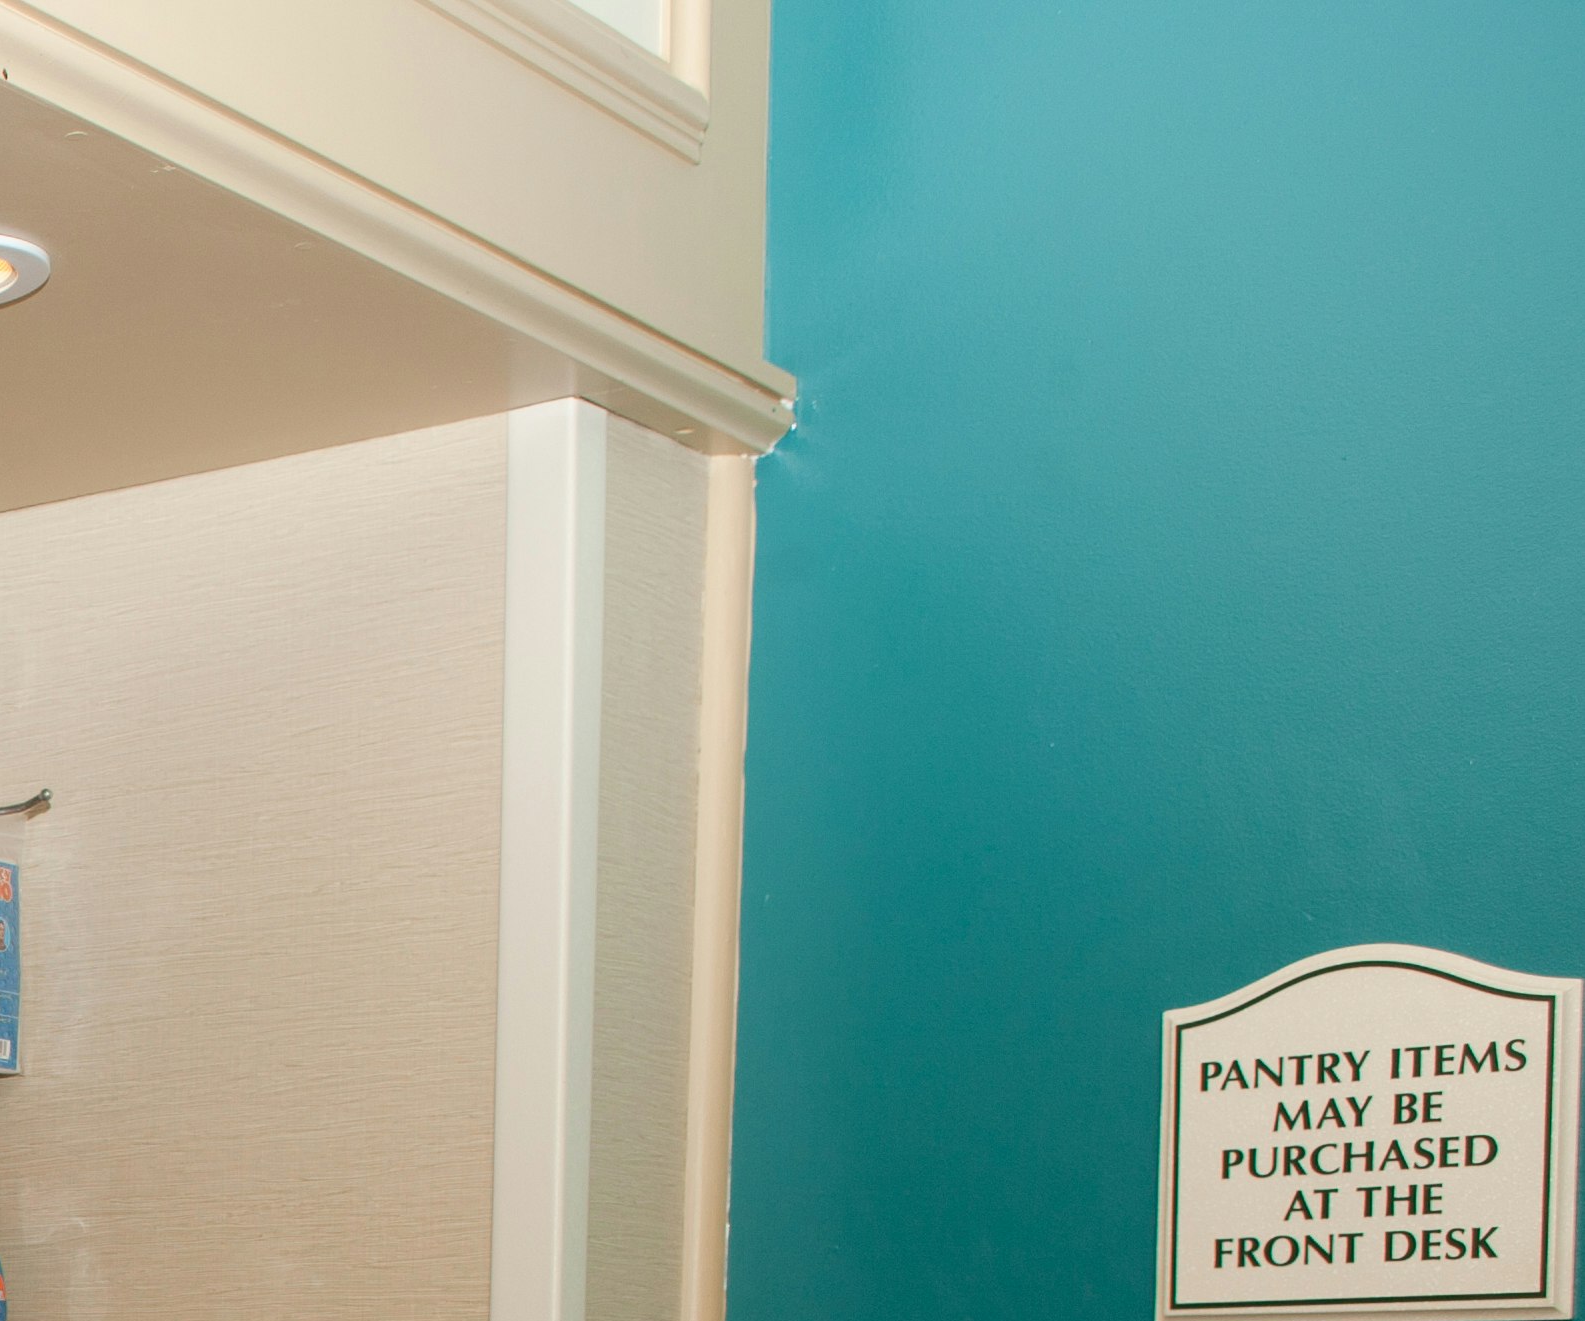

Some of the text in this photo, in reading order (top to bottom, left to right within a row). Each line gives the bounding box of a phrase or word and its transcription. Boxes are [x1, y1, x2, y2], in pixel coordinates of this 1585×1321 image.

[1199, 1038, 1528, 1093] PANTRY ITEMS
[1272, 1090, 1444, 1133] MAY BE
[1220, 1133, 1500, 1181] PURCHASED
[1283, 1182, 1444, 1222] AT THE
[1213, 1225, 1500, 1270] FRONT DESK
